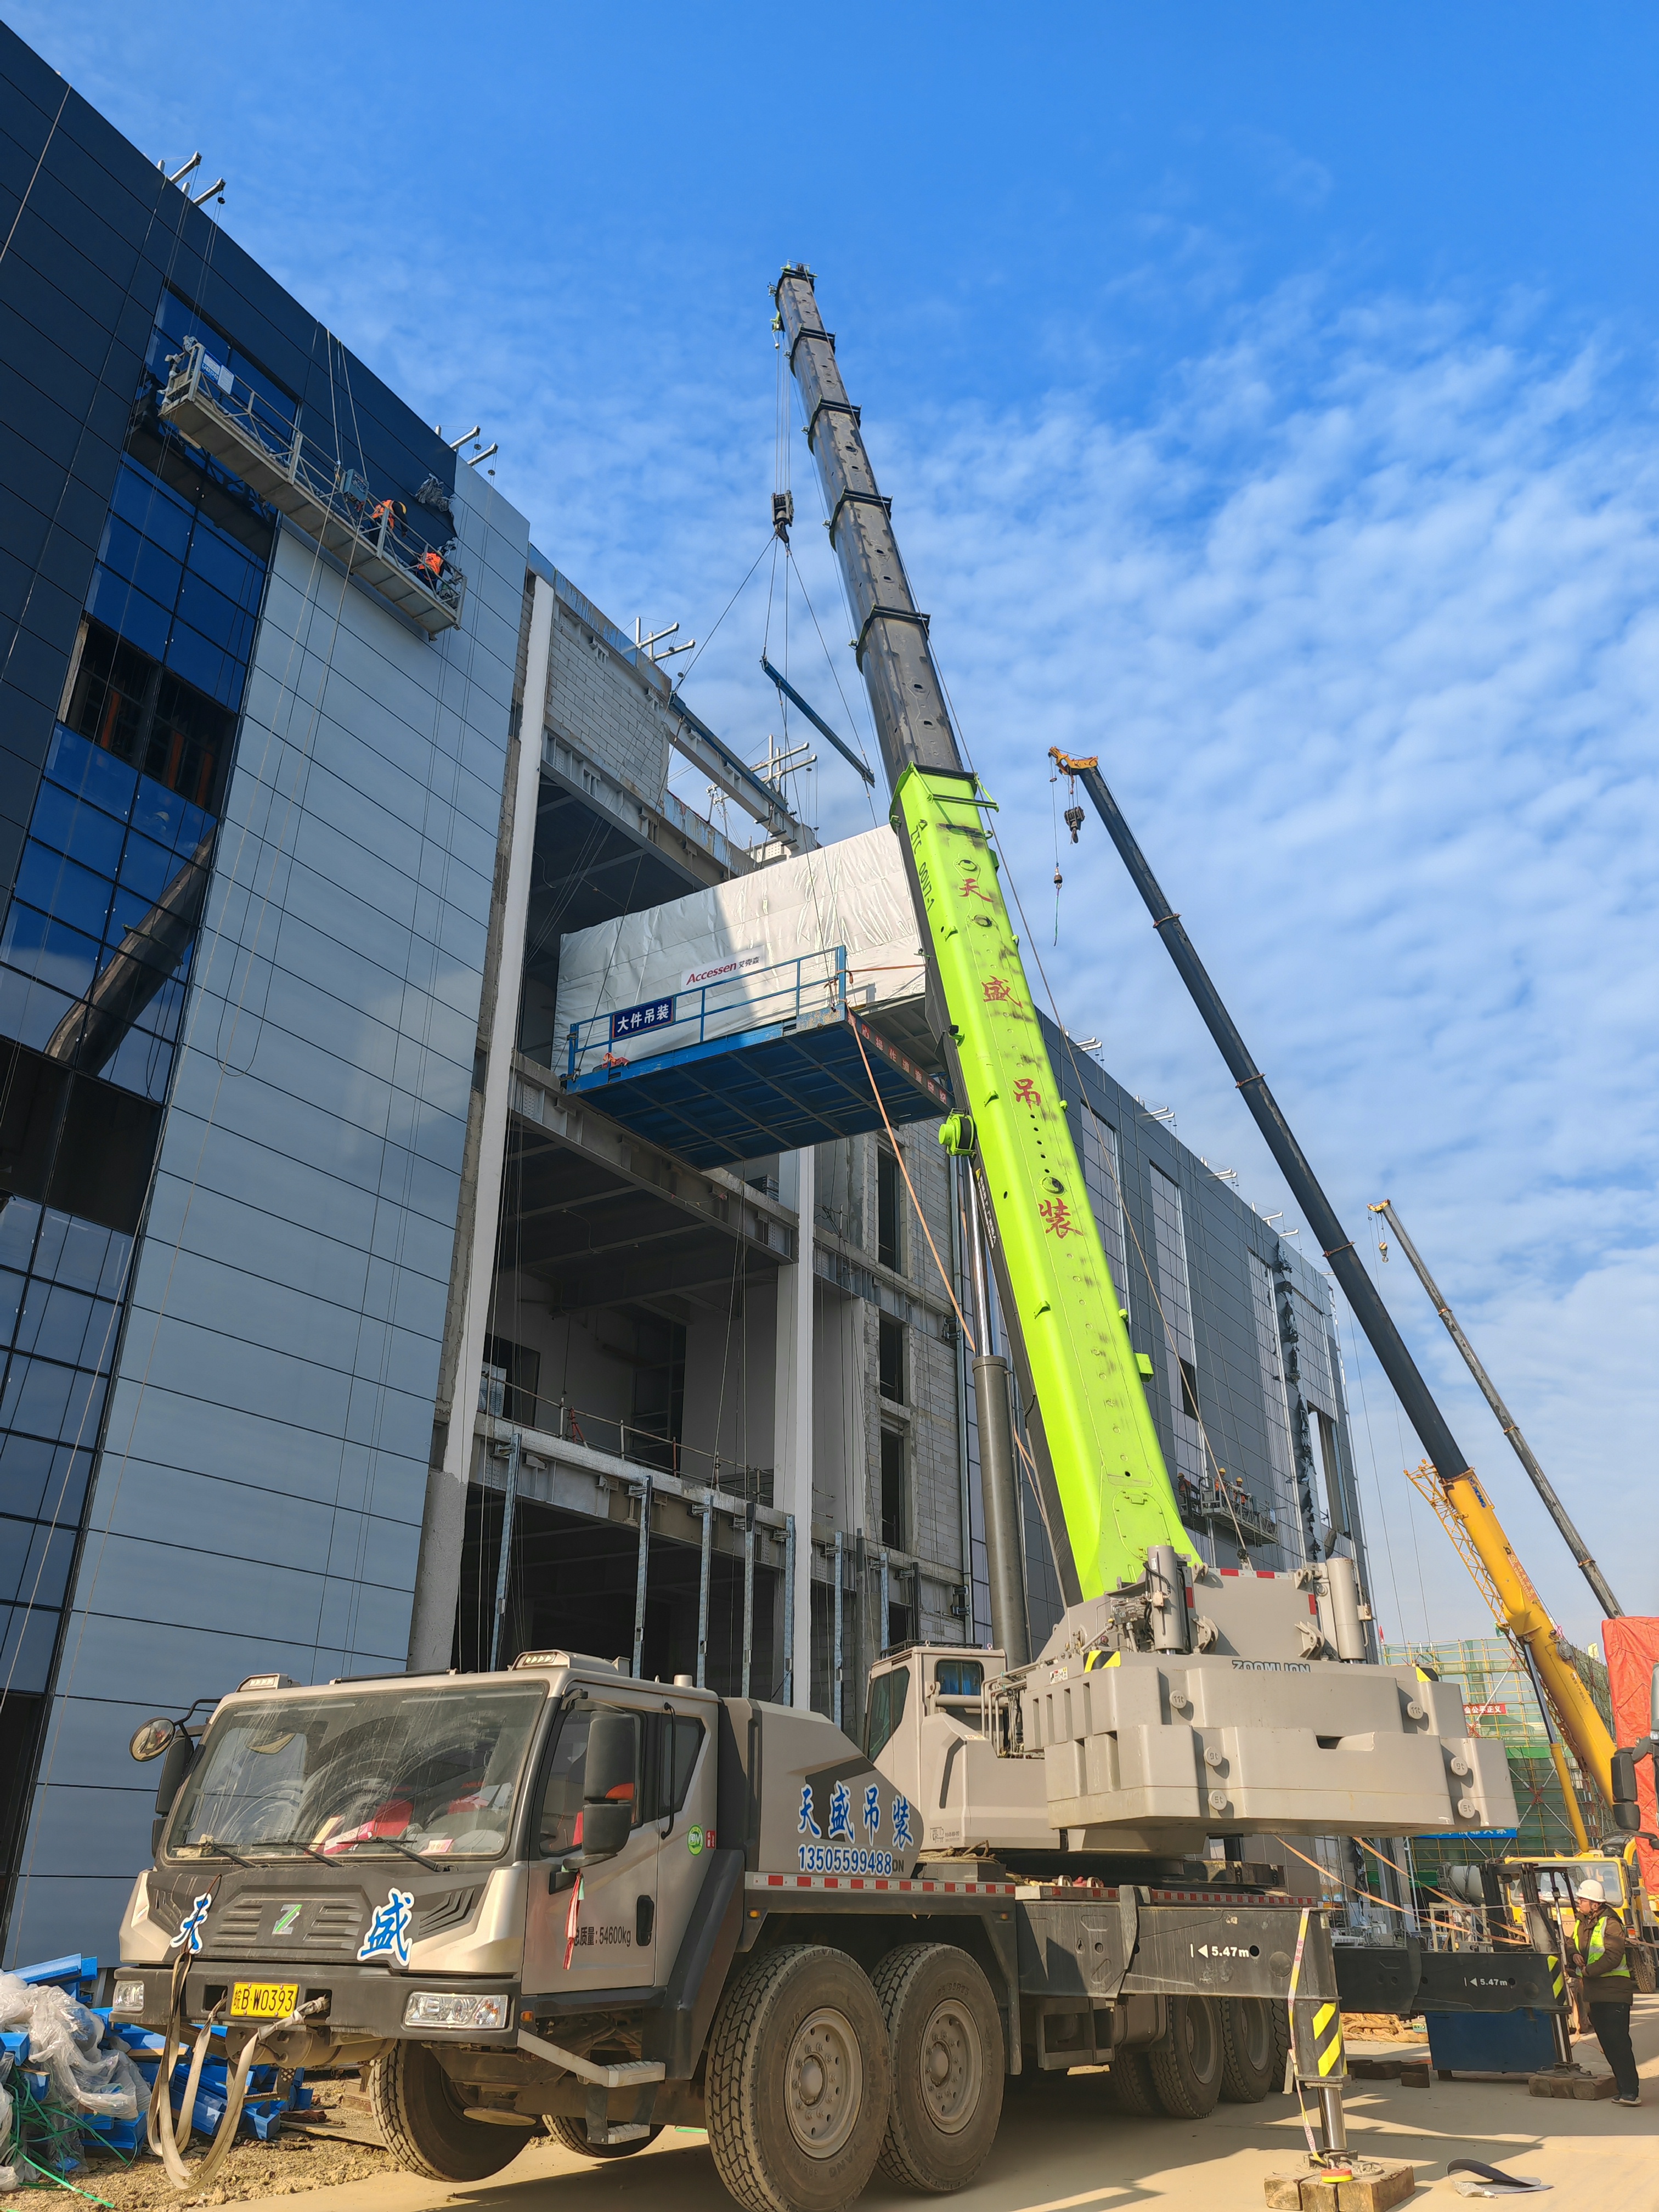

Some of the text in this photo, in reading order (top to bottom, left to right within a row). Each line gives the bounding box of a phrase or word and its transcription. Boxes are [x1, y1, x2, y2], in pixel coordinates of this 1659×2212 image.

[686, 962, 737, 986] Accessen
[738, 956, 760, 969] 艾克森
[617, 1003, 669, 1033] 大件吊装
[1463, 1705, 1502, 1714] 会公平正义
[798, 1782, 913, 1850] 天盛吊装
[799, 1844, 893, 1876] 13505599488
[358, 1890, 413, 1964] 盛
[1211, 1946, 1250, 1958] 5.47m
